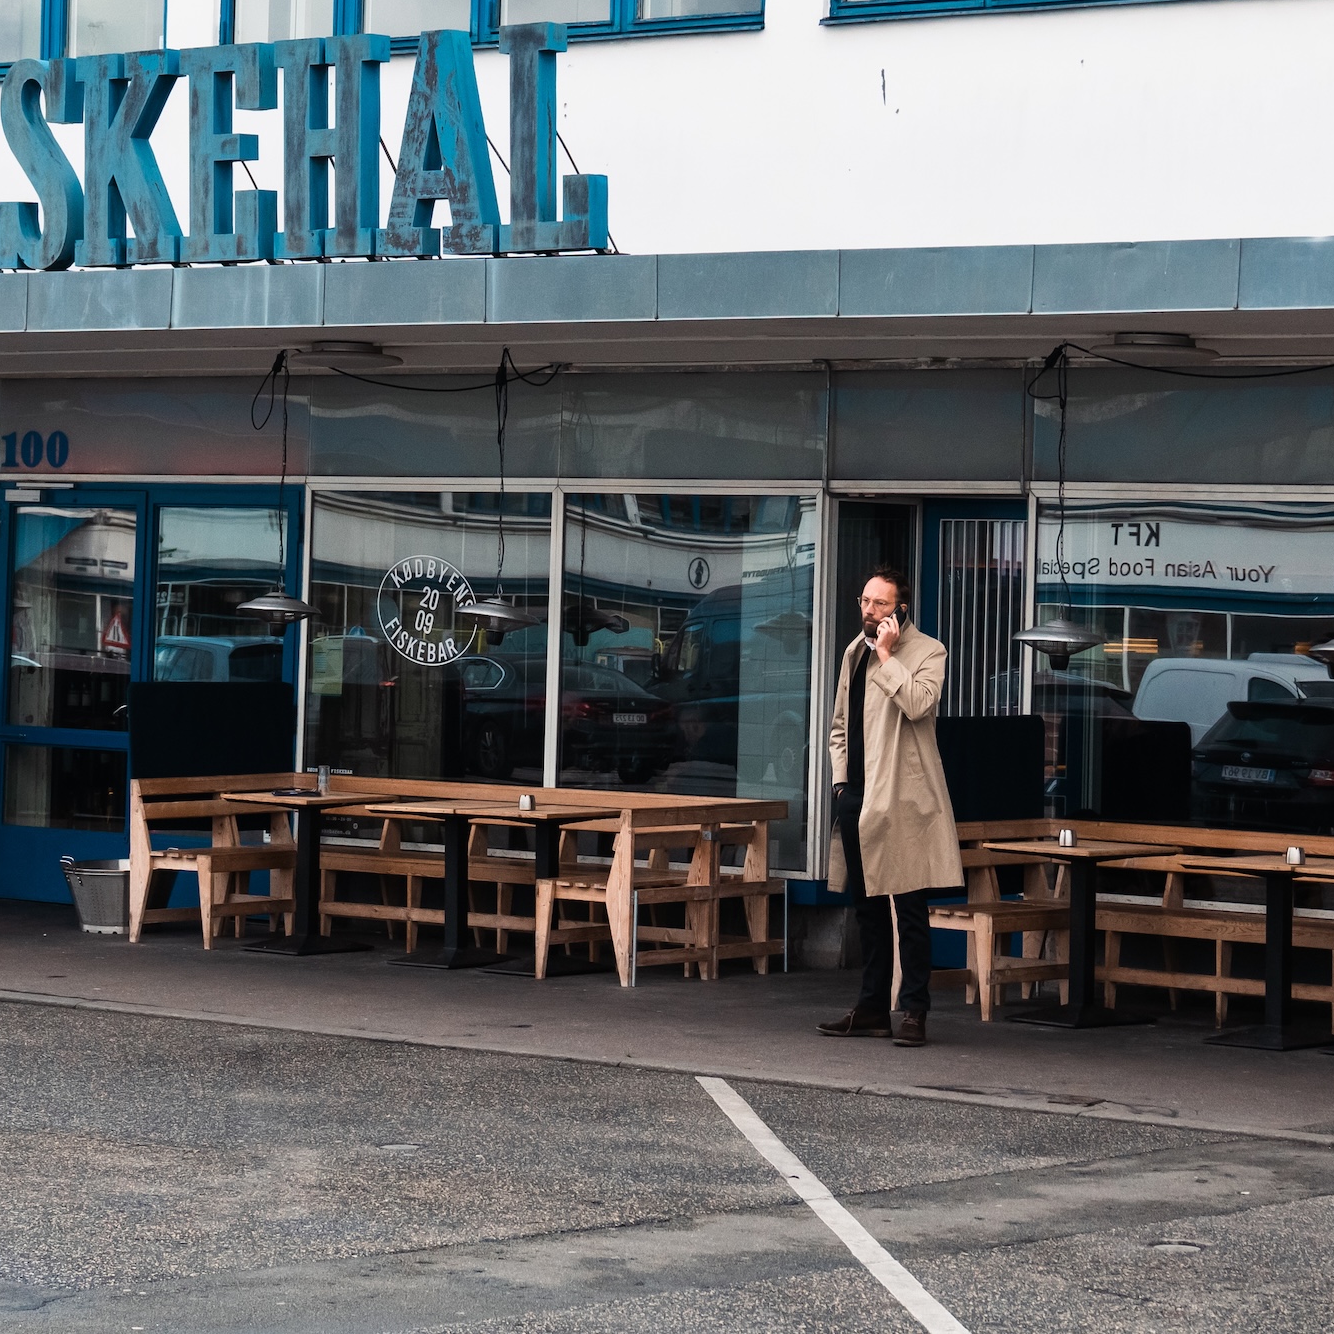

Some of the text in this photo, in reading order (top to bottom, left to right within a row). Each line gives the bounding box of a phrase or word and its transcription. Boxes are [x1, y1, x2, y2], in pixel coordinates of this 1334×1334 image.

[1, 430, 69, 468] 100
[419, 586, 440, 611] 20
[415, 610, 434, 634] 09
[385, 616, 459, 663] FISKEBAR
